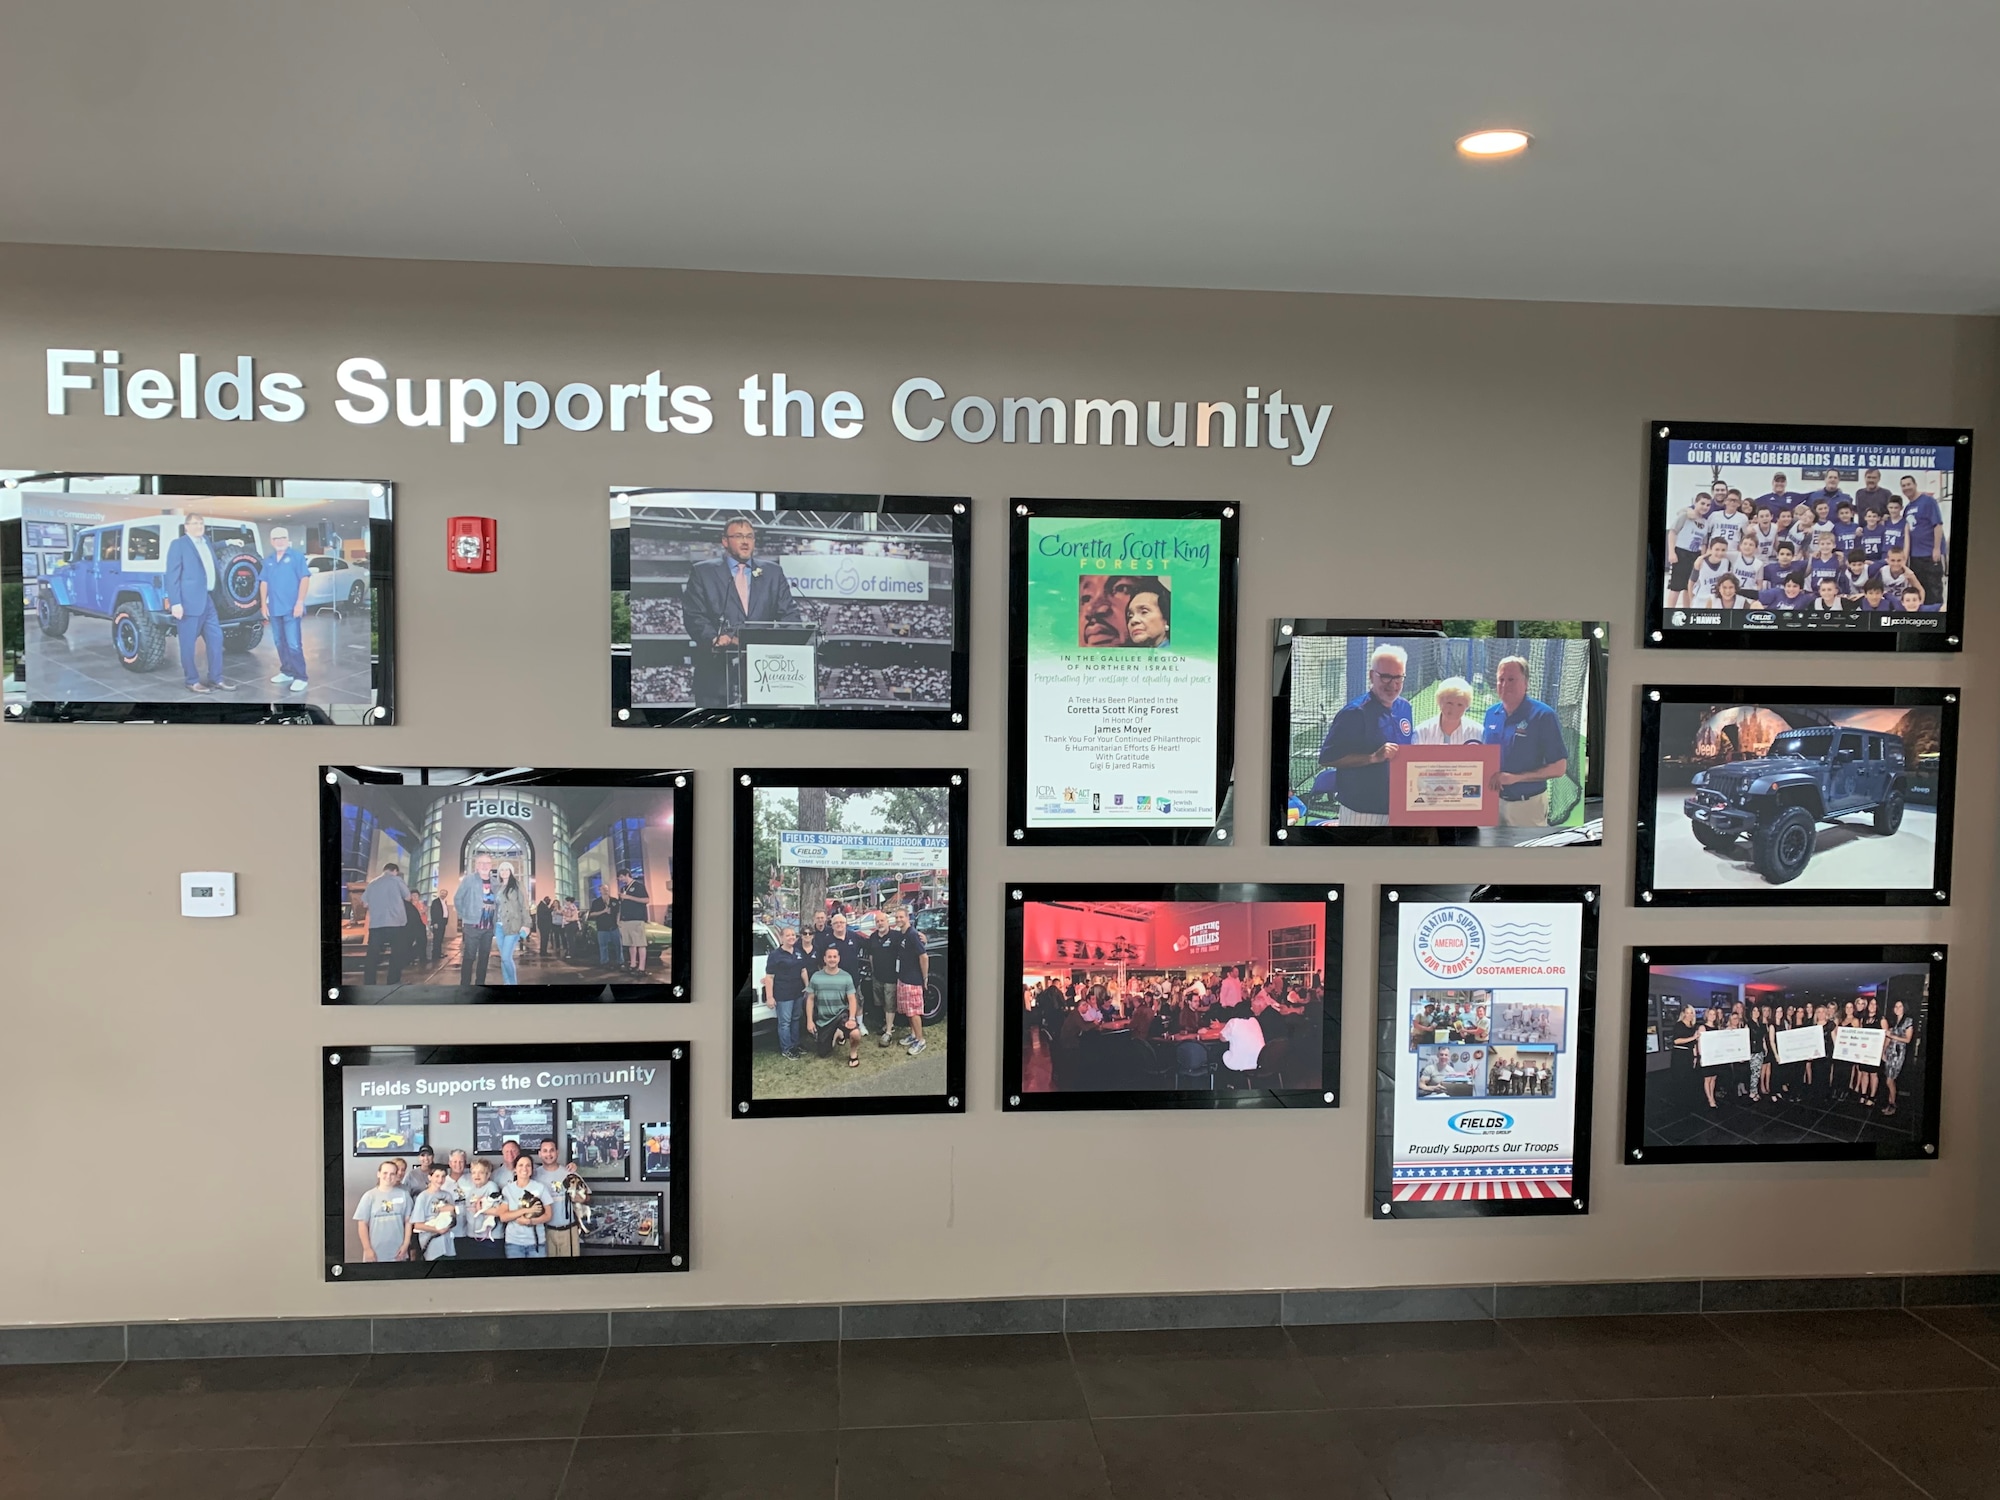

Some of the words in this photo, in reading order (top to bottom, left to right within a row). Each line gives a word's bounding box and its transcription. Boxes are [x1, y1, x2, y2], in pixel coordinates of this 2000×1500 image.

[46, 348, 306, 423] Fields
[335, 357, 713, 445] Supports
[739, 373, 864, 438] the
[891, 377, 1333, 466] Community
[1810, 445, 1836, 453] THANK
[1687, 450, 1712, 463] OUR
[1715, 451, 1742, 463] NEW
[1744, 452, 1831, 466] SCOREBOARDS
[1833, 454, 1855, 466] ARE
[1858, 454, 1866, 467] A
[1868, 455, 1900, 467] SLAM
[1903, 456, 1936, 468] DUNK
[56, 509, 105, 521] Community
[1720, 529, 1735, 540] 22
[1039, 534, 1112, 559] Coretta
[1119, 532, 1167, 561] Scott
[1174, 537, 1210, 569] King
[1844, 540, 1855, 549] 13
[1865, 544, 1878, 554] 24
[1080, 559, 1171, 570] FOREST
[861, 575, 877, 592] of
[879, 576, 924, 593] dimes
[1740, 577, 1747, 587] 7
[754, 659, 796, 683] SPORTS
[760, 669, 807, 692] Awards
[1034, 673, 1081, 685] Perpetuating
[1142, 674, 1171, 686] equality
[1173, 674, 1188, 683] and
[1190, 675, 1212, 686] peace
[1067, 706, 1100, 714] Coretta
[1102, 706, 1126, 714] Scott
[1128, 706, 1148, 716] King
[1150, 706, 1179, 714] Forest
[1111, 716, 1133, 724] Honor
[1094, 725, 1121, 735] James
[1124, 725, 1152, 735] Moyer
[1153, 736, 1201, 744] Philanthropic
[1090, 762, 1103, 771] Gigi
[1112, 762, 1130, 770] Jared
[1035, 785, 1056, 797] JCPA
[1078, 789, 1090, 797] ACT
[1911, 786, 1930, 794] Jeep
[464, 799, 532, 819] Fields
[785, 833, 815, 844] FIELDS
[818, 835, 864, 845] SUPPORTS
[867, 836, 922, 847] NORTHBROOK
[925, 838, 947, 847] DAYS
[1189, 920, 1219, 936] FIGHTING
[1418, 911, 1454, 949] OPERATION
[1456, 911, 1480, 949] SUPPORT
[1189, 932, 1219, 946] FAMILIES
[1434, 938, 1464, 948] AMERICA
[1423, 955, 1440, 973] OUR
[1442, 956, 1473, 975] TROOPS
[1476, 966, 1566, 975] OSOTAMERICA.ORG
[361, 1080, 411, 1097] Fields
[416, 1076, 496, 1097] Supports
[501, 1074, 531, 1090] the
[536, 1065, 656, 1085] Community
[1460, 1118, 1504, 1128] FIELDS
[1408, 1144, 1449, 1155] Proudly
[1452, 1143, 1500, 1155] Supports
[1502, 1143, 1522, 1153] Our
[1524, 1142, 1559, 1153] Troops
